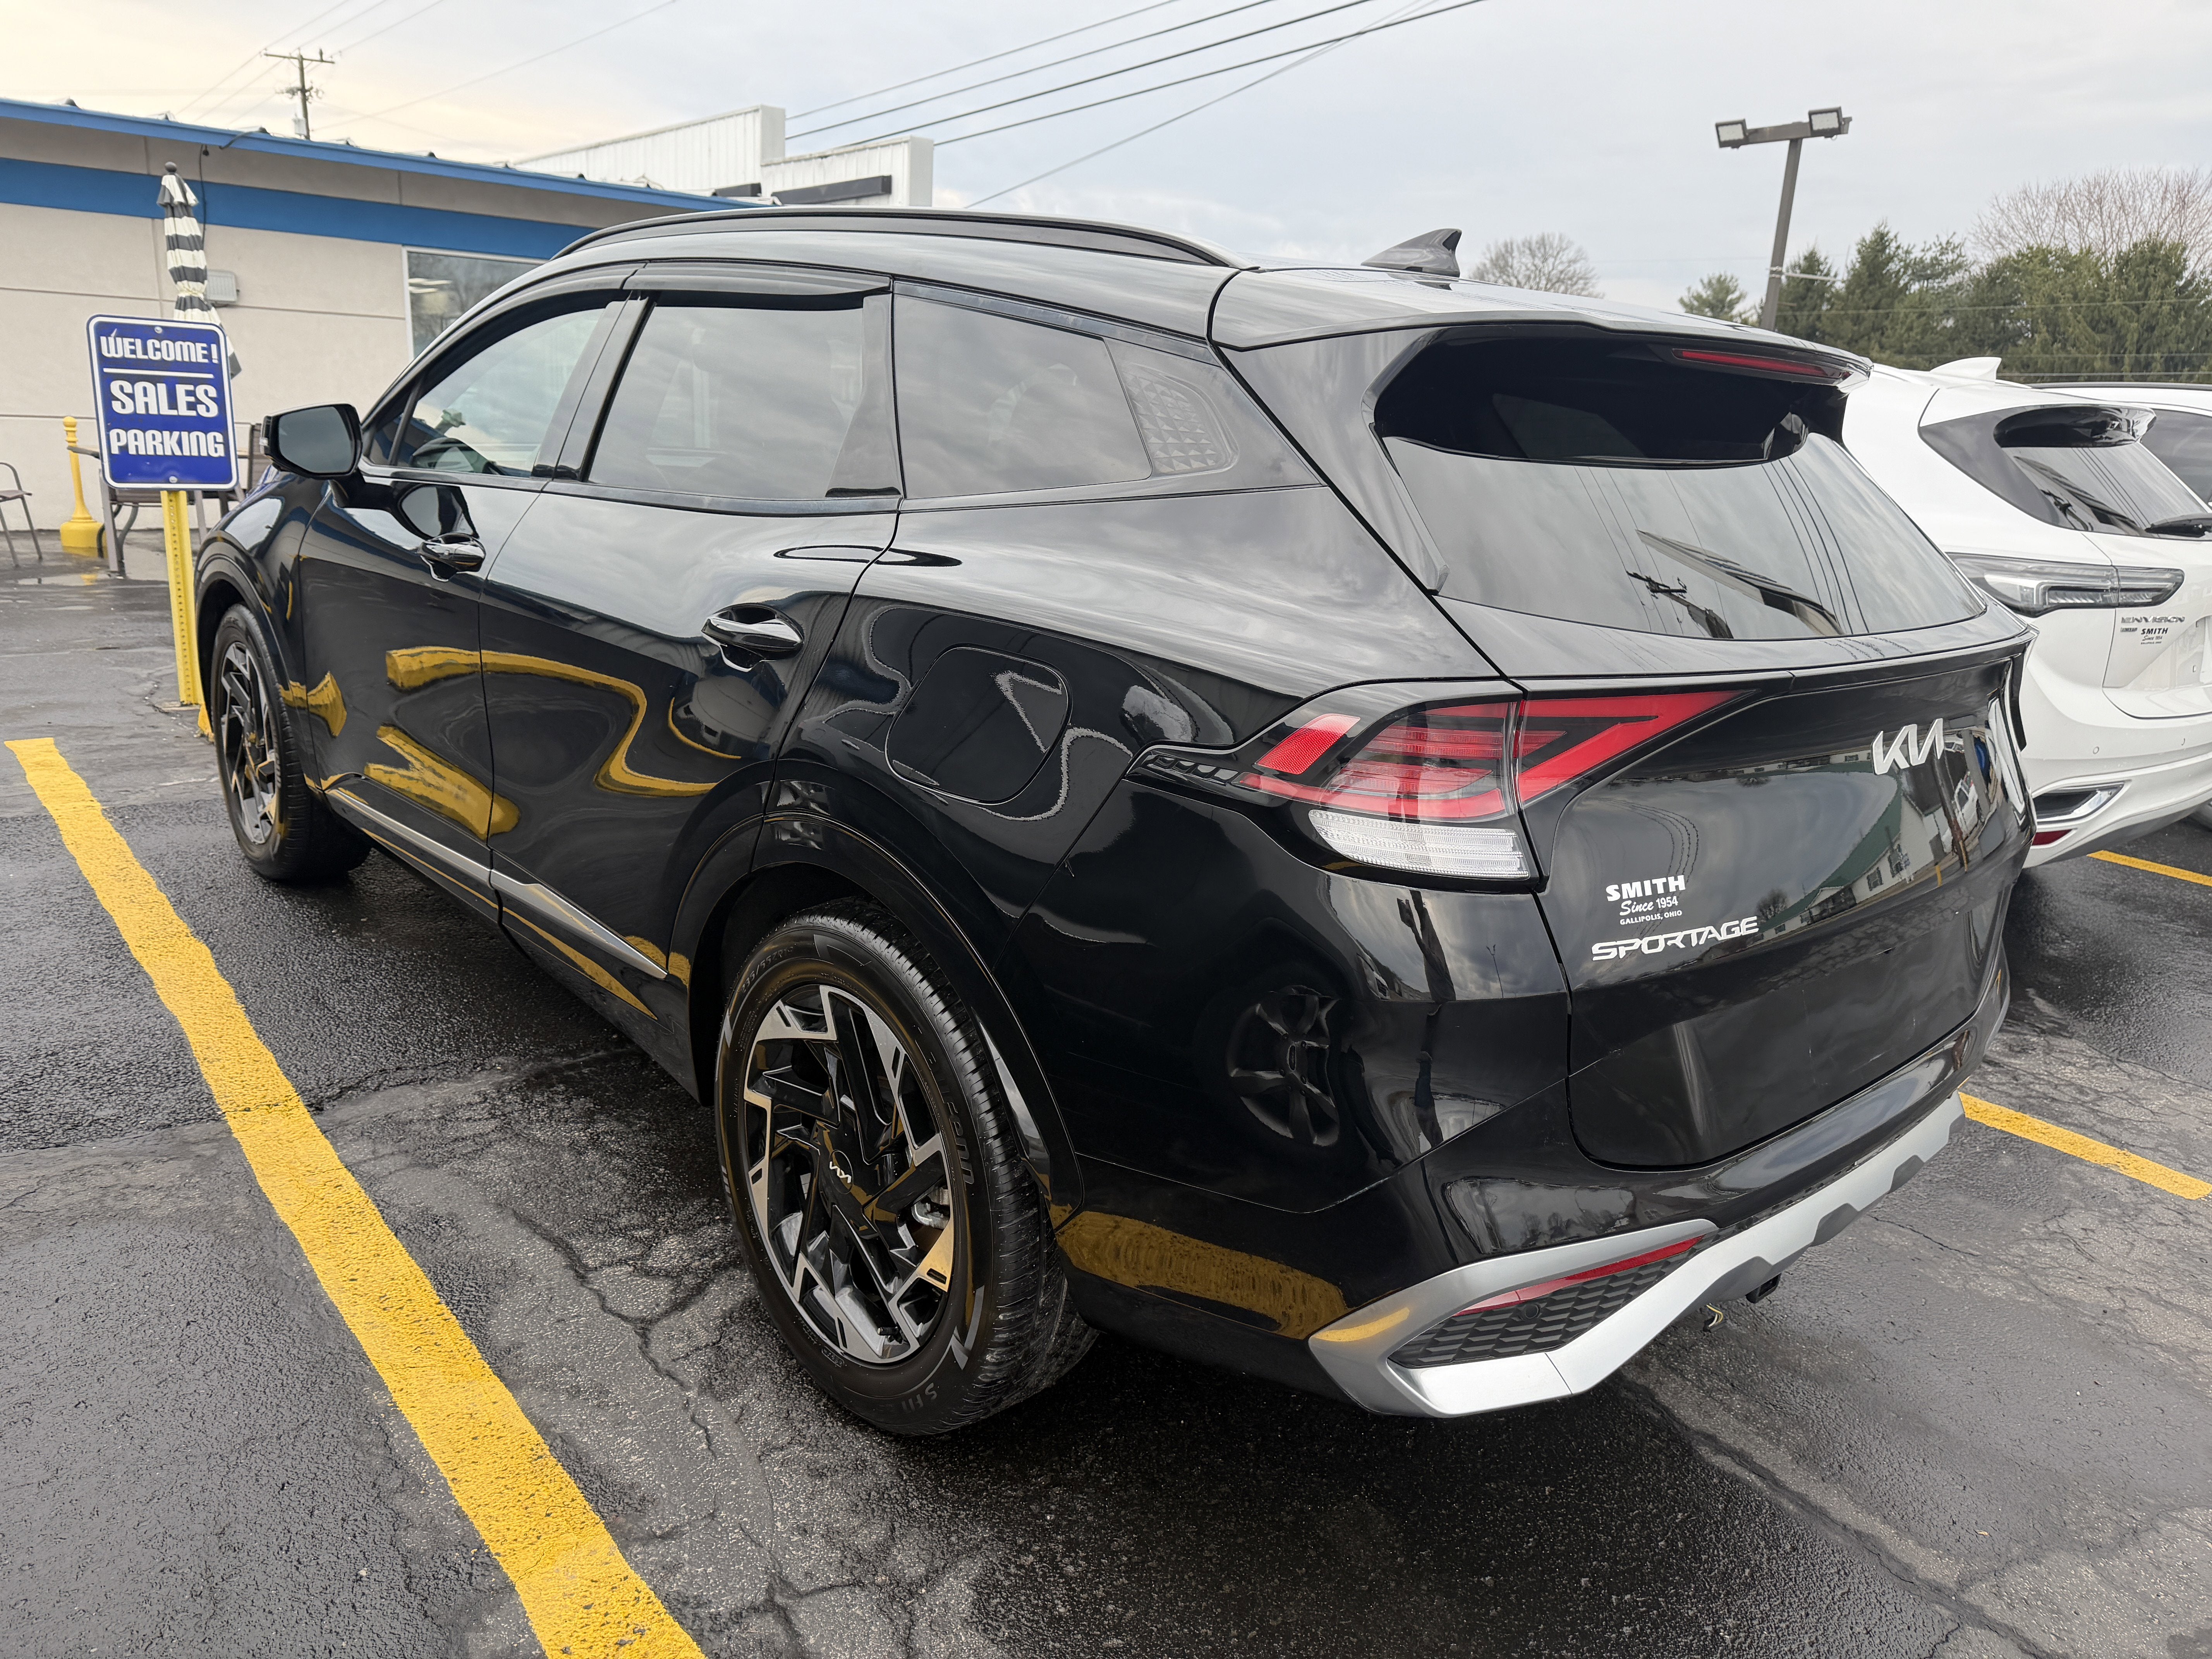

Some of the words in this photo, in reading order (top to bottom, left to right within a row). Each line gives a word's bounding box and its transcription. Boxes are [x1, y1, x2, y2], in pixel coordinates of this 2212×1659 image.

[100, 336, 219, 364] WELCOME!
[110, 380, 218, 417] SALES
[109, 429, 225, 457] PARKING
[2121, 615, 2185, 623] ENVISION
[1872, 718, 1944, 775] KIA
[1606, 875, 1686, 902] SMITH
[1619, 900, 1654, 915] Since
[1656, 896, 1678, 908] 1954
[1620, 913, 1663, 925] GALLIPOLIS,
[1664, 910, 1682, 918] OHIO
[1592, 916, 1759, 961] SPORTAGE
